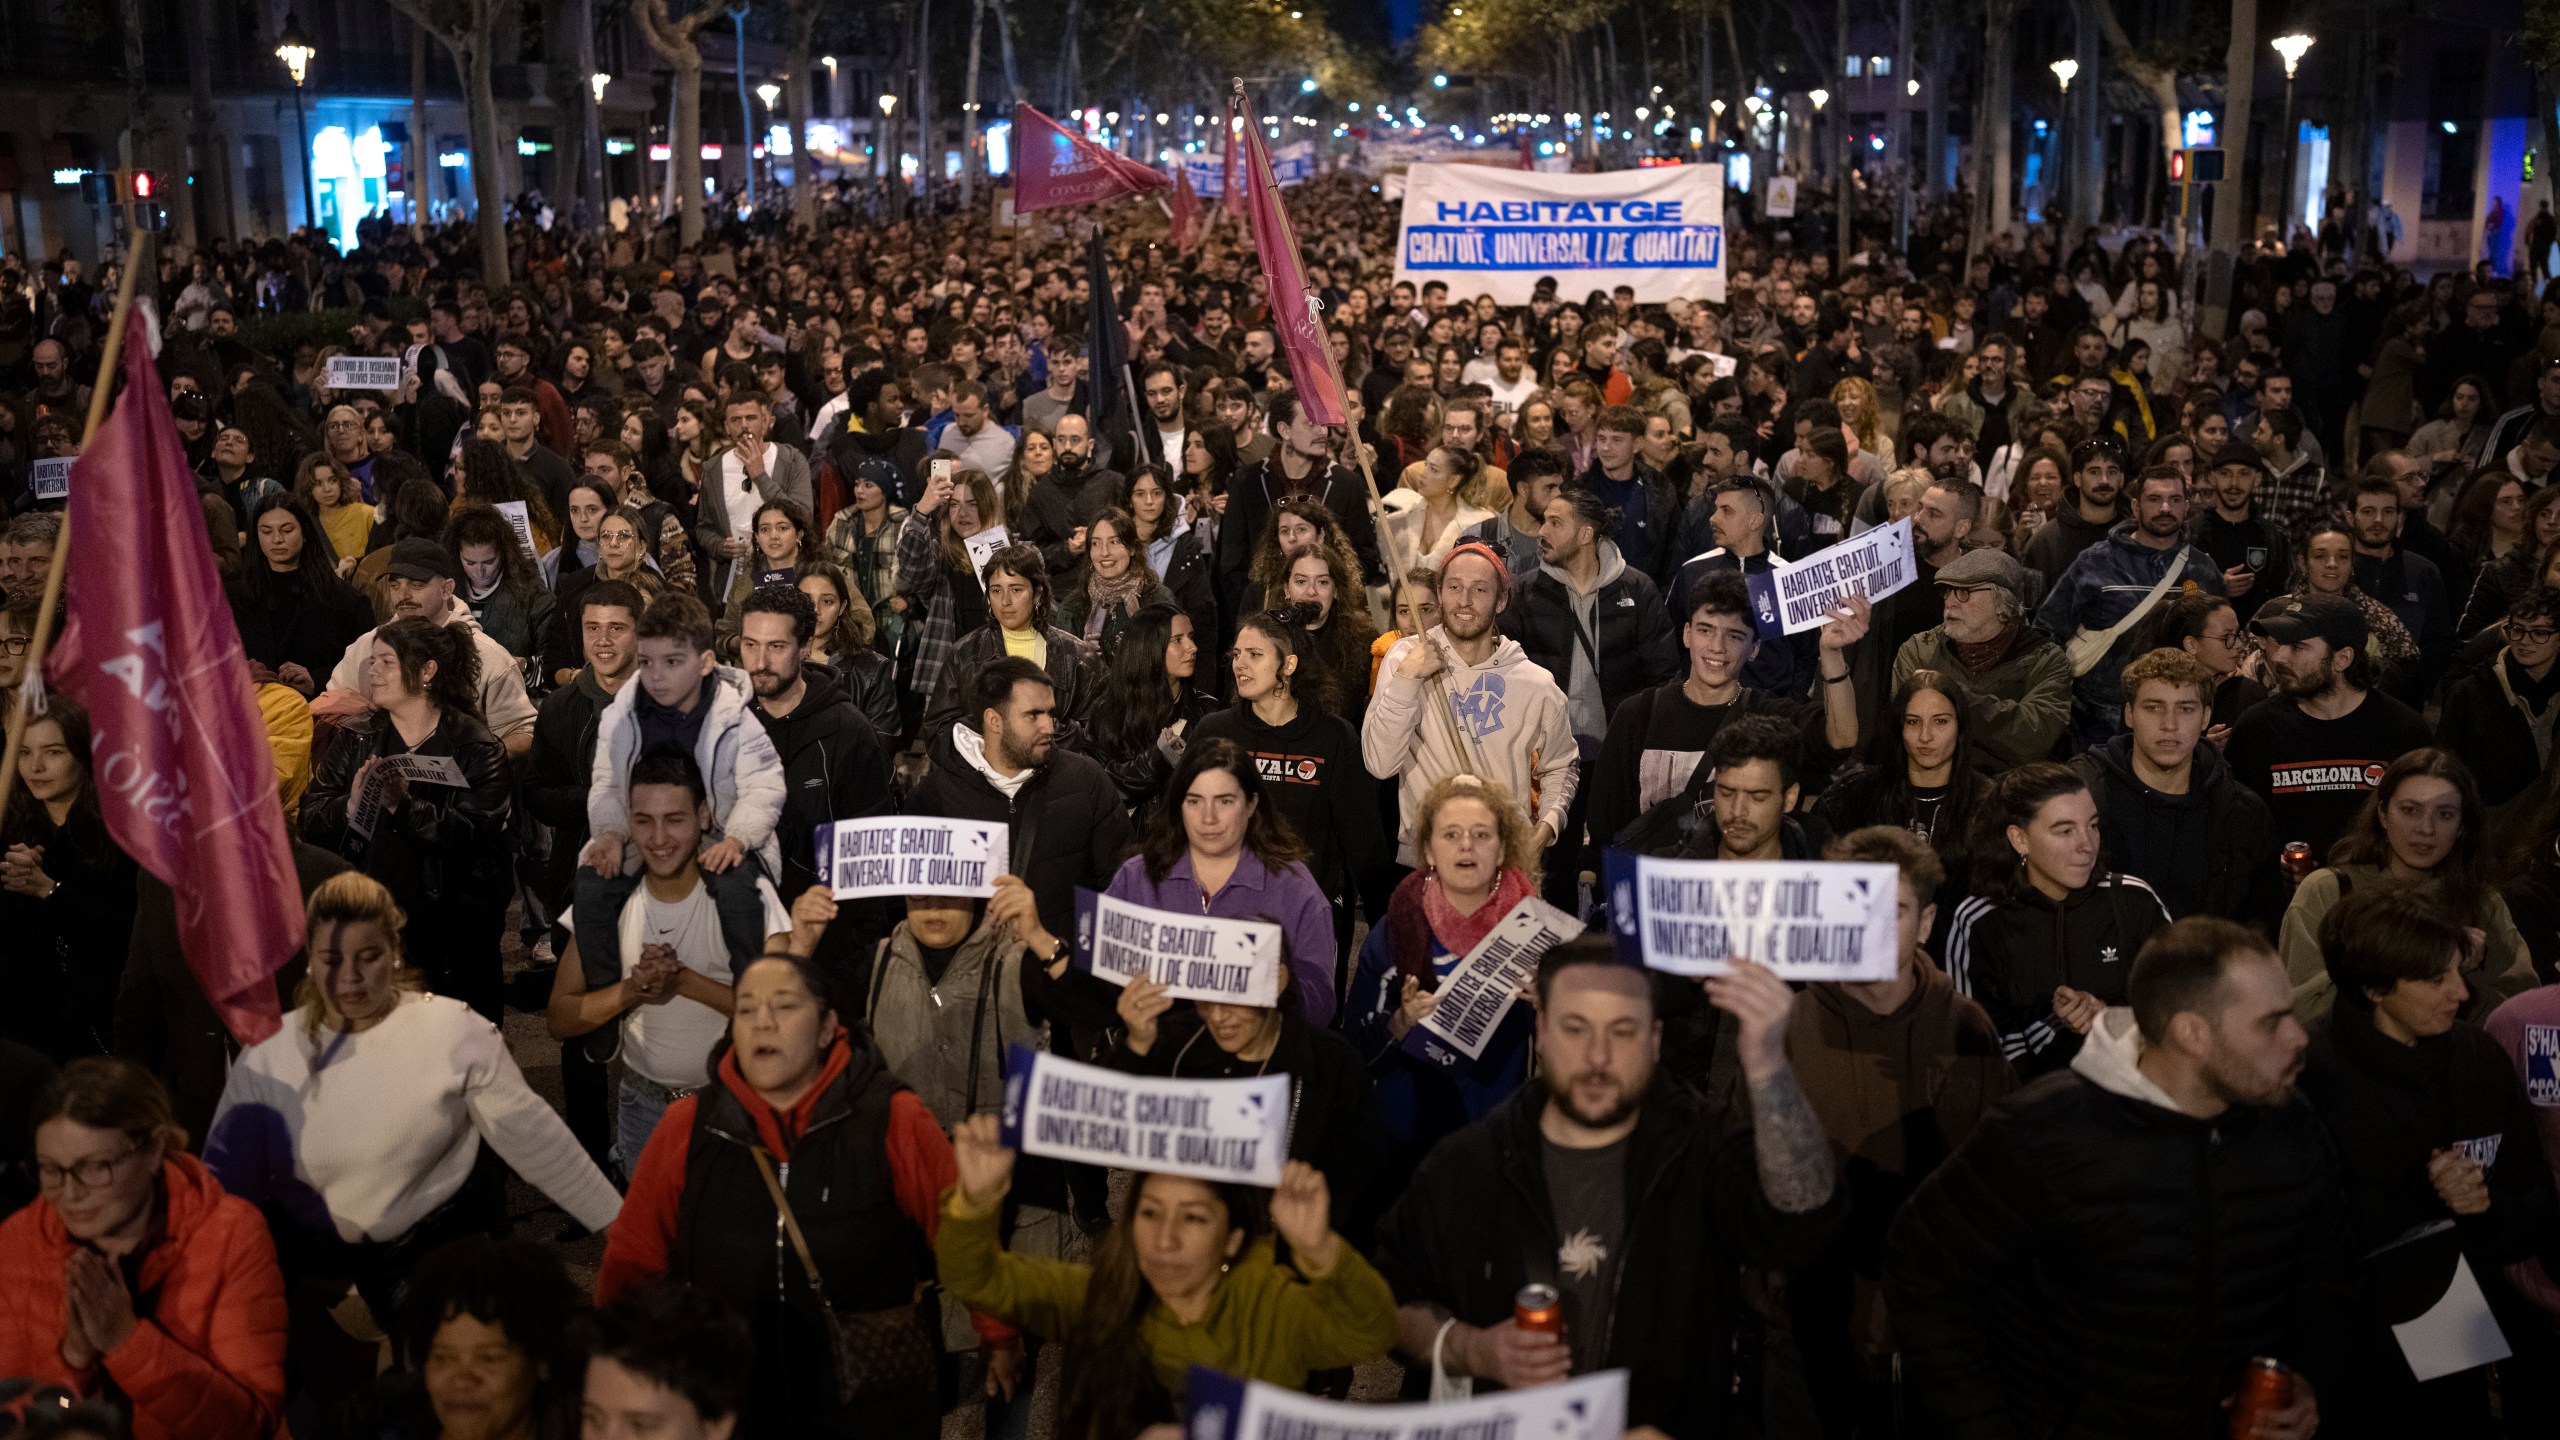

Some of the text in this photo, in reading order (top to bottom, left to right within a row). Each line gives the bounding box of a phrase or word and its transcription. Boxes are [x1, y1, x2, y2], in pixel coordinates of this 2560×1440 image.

[1437, 201, 1683, 222] HABITATGE
[1494, 231, 1590, 264] UNIVERSAL
[1595, 231, 1604, 262] I
[1606, 231, 1632, 262] DE
[1633, 229, 1719, 262] QUALITAT
[36, 463, 65, 479] HABITATGE
[37, 478, 67, 494] UNIVERSAL
[1781, 540, 1883, 600] HABITATGE GRATUÏT,
[1787, 585, 1846, 625] UNIVERSAL
[1851, 577, 1867, 598] DE
[1867, 557, 1903, 597] QUALITAT
[402, 767, 449, 782] QUALITAT
[2272, 767, 2362, 787] BARCELONA
[2305, 784, 2356, 792] ANTIFEIXISTA
[839, 828, 896, 859] HABITATGE
[900, 825, 954, 856] GRATUÏT,
[838, 858, 987, 889] UNIVERSAL I DE QUALITAT
[1103, 908, 1156, 951] HABITATGE
[1158, 924, 1218, 959] GRATUÏT,
[1786, 924, 1866, 964] QUALITAT
[1156, 957, 1164, 984] I
[1166, 958, 1182, 987] DE
[1186, 961, 1252, 994] QUALITAT
[1431, 971, 1486, 1033] HABITATGE
[1470, 935, 1523, 978] GRATUÏT,
[1453, 925, 1562, 1047] UNIVERSAL I DE QUALITAT
[1040, 1073, 1129, 1122] HABITATGE
[1036, 1112, 1261, 1172] UNIVERSAL I DE QUALITAT
